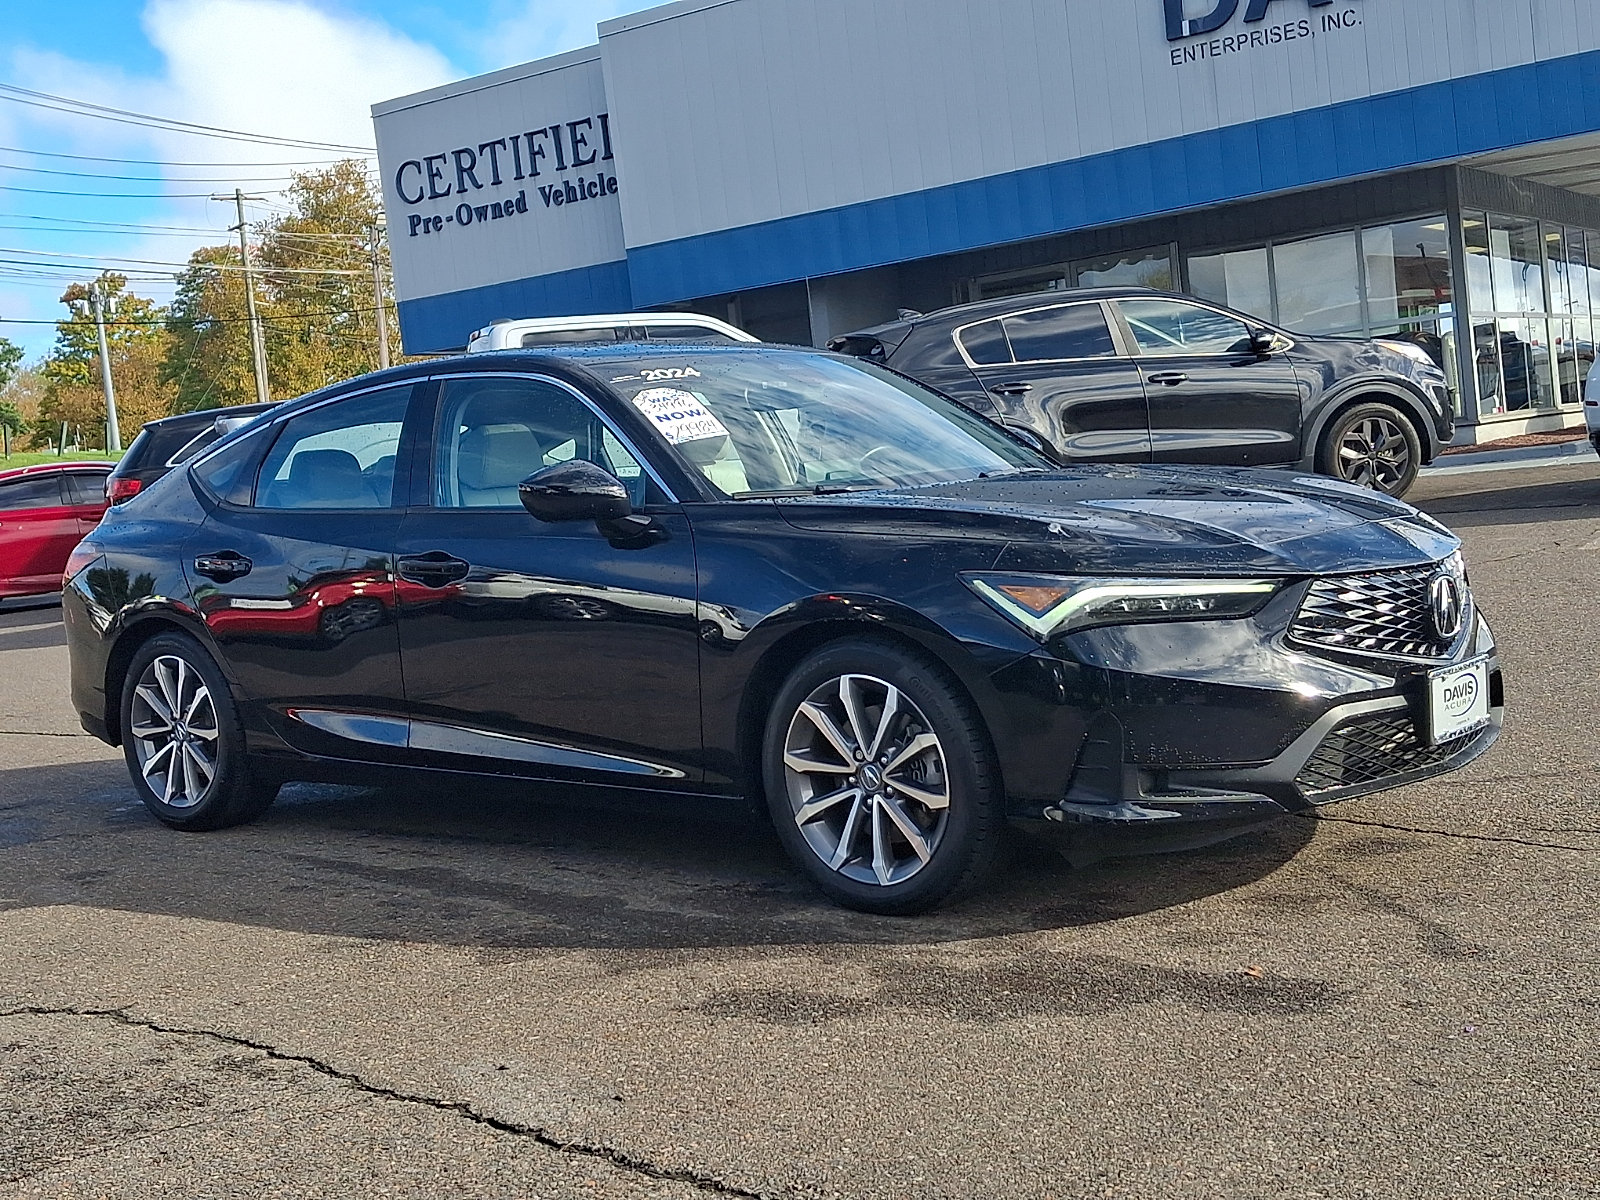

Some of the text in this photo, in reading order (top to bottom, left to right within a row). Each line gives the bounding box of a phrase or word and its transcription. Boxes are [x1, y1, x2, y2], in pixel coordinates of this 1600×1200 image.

[1170, 9, 1362, 66] ENTERPRISES, INC.
[408, 190, 528, 236] Pre-Owned
[655, 409, 701, 422] NOW
[1444, 681, 1473, 703] DAVIS
[1444, 697, 1472, 711] ACURA
